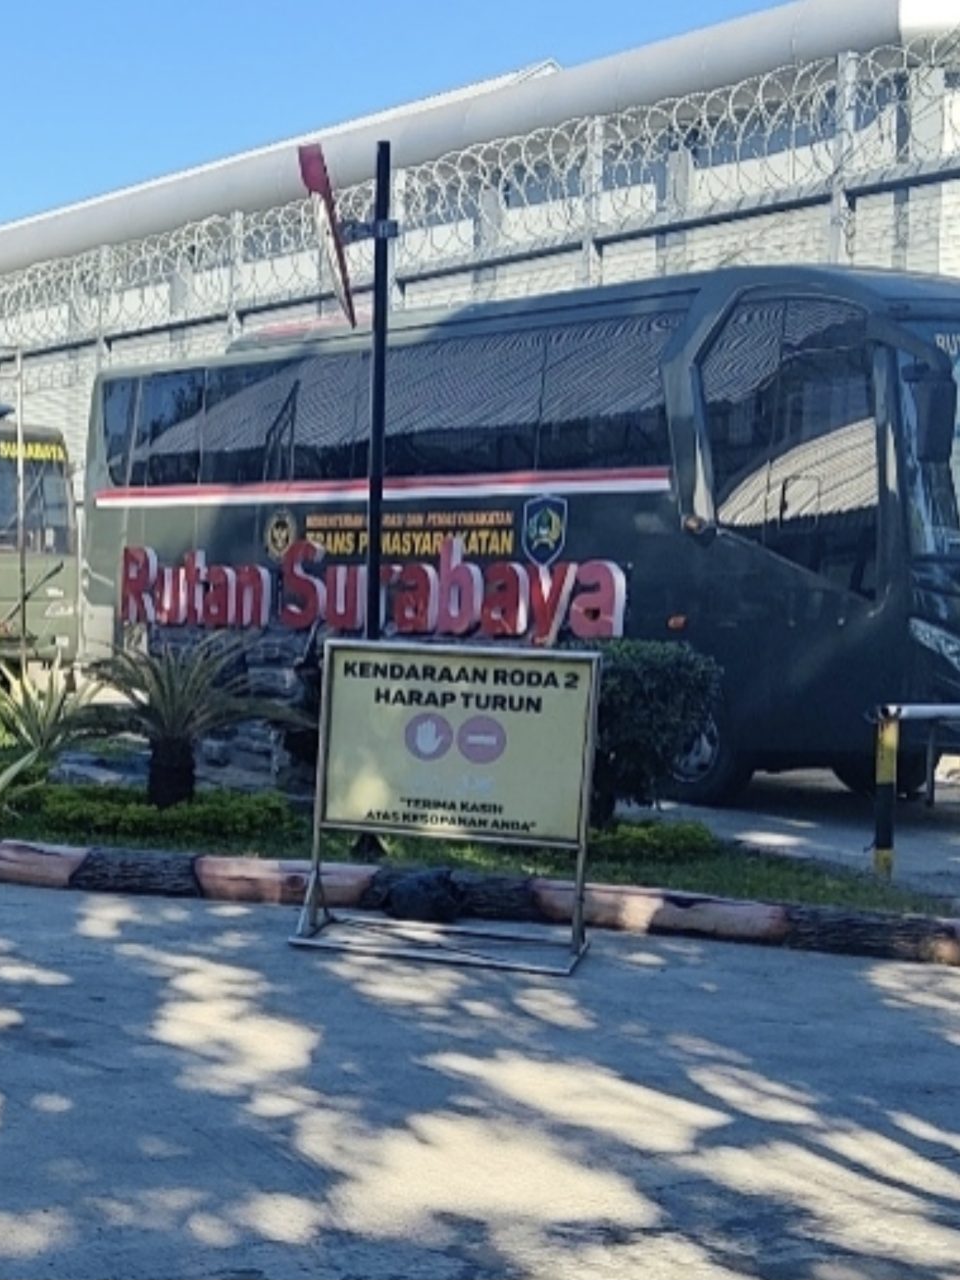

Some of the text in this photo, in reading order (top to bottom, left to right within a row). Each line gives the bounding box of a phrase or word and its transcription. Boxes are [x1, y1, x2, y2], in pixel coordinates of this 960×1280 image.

[121, 545, 271, 628] Rutan
[343, 660, 580, 689] KENDARAAN RODA 2
[374, 688, 543, 713] HARAP TURUN
[365, 809, 400, 821] ATAS
[402, 811, 488, 828] KESOPANAN
[460, 801, 503, 815] KASIH
